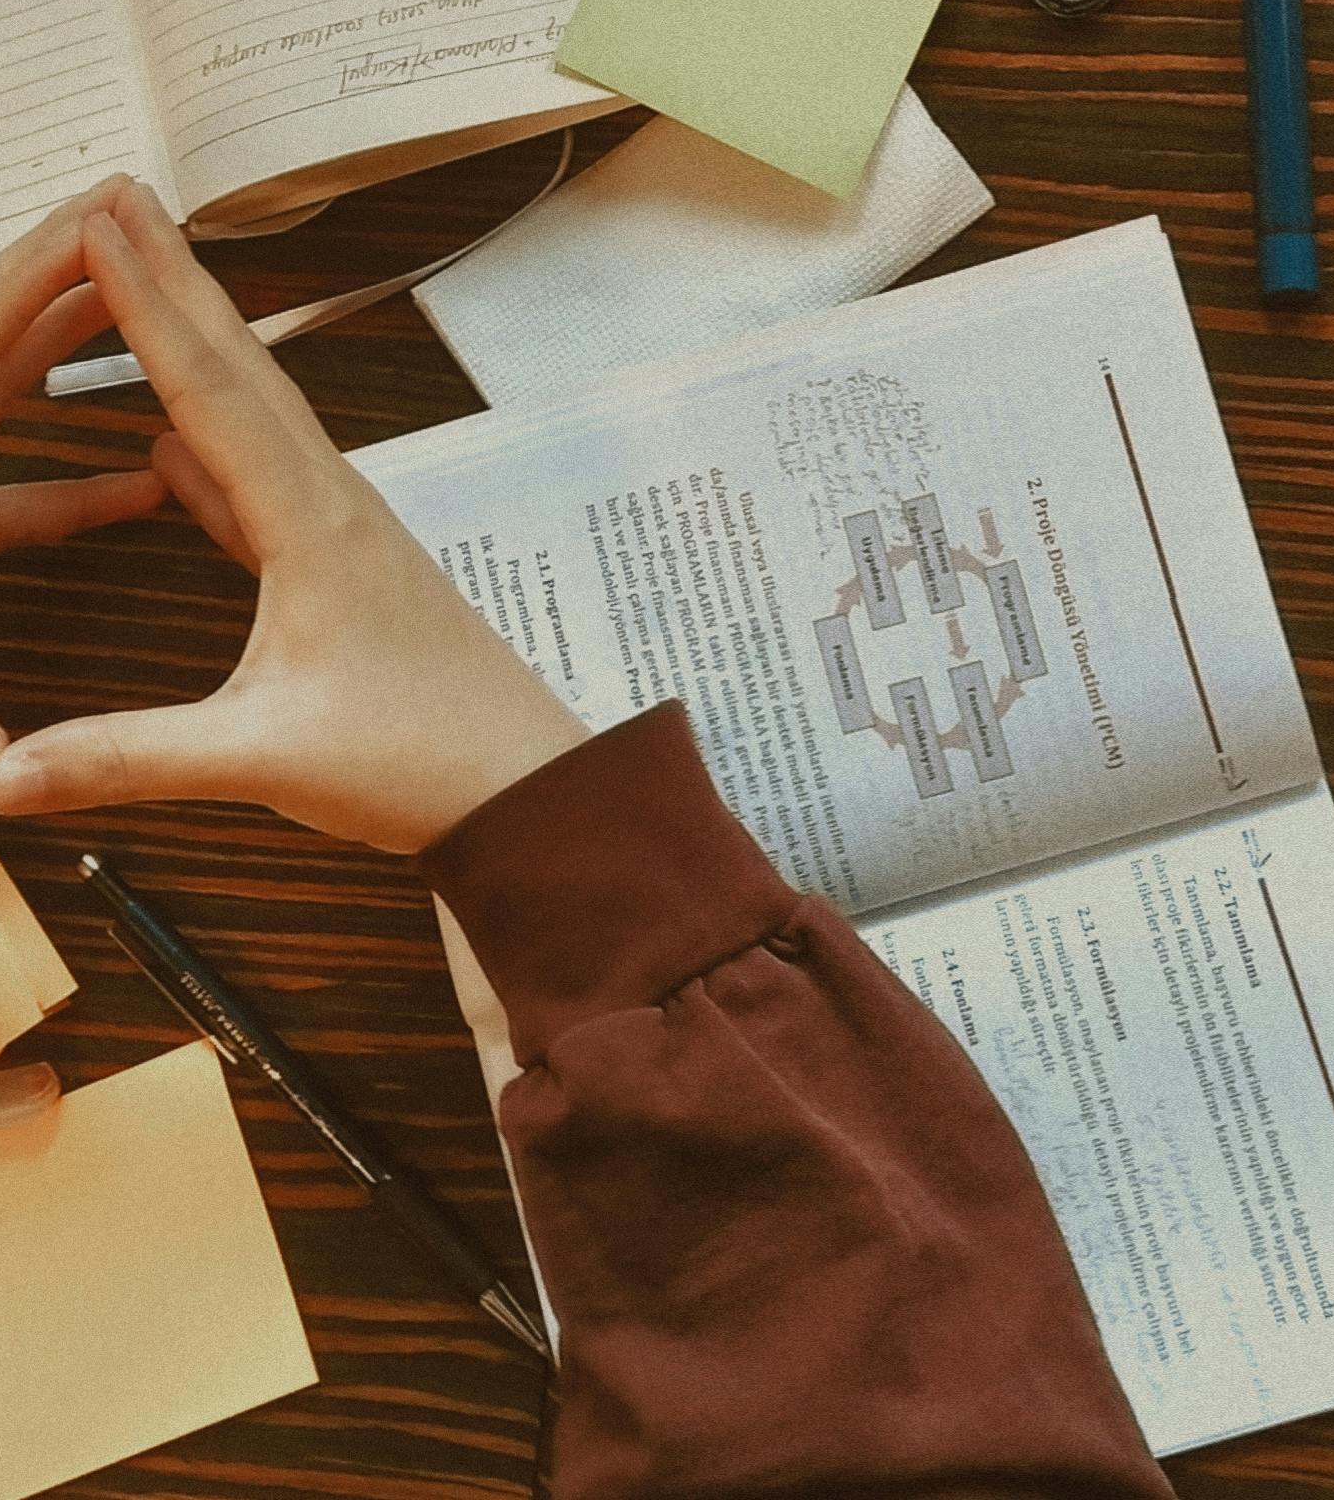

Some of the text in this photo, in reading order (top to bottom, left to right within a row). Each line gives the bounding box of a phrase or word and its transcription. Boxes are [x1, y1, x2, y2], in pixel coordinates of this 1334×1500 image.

[674, 508, 721, 629] PROGRAMLARIN
[727, 619, 773, 736] PROGRAMLARA
[1089, 712, 1128, 772] (PCM)
